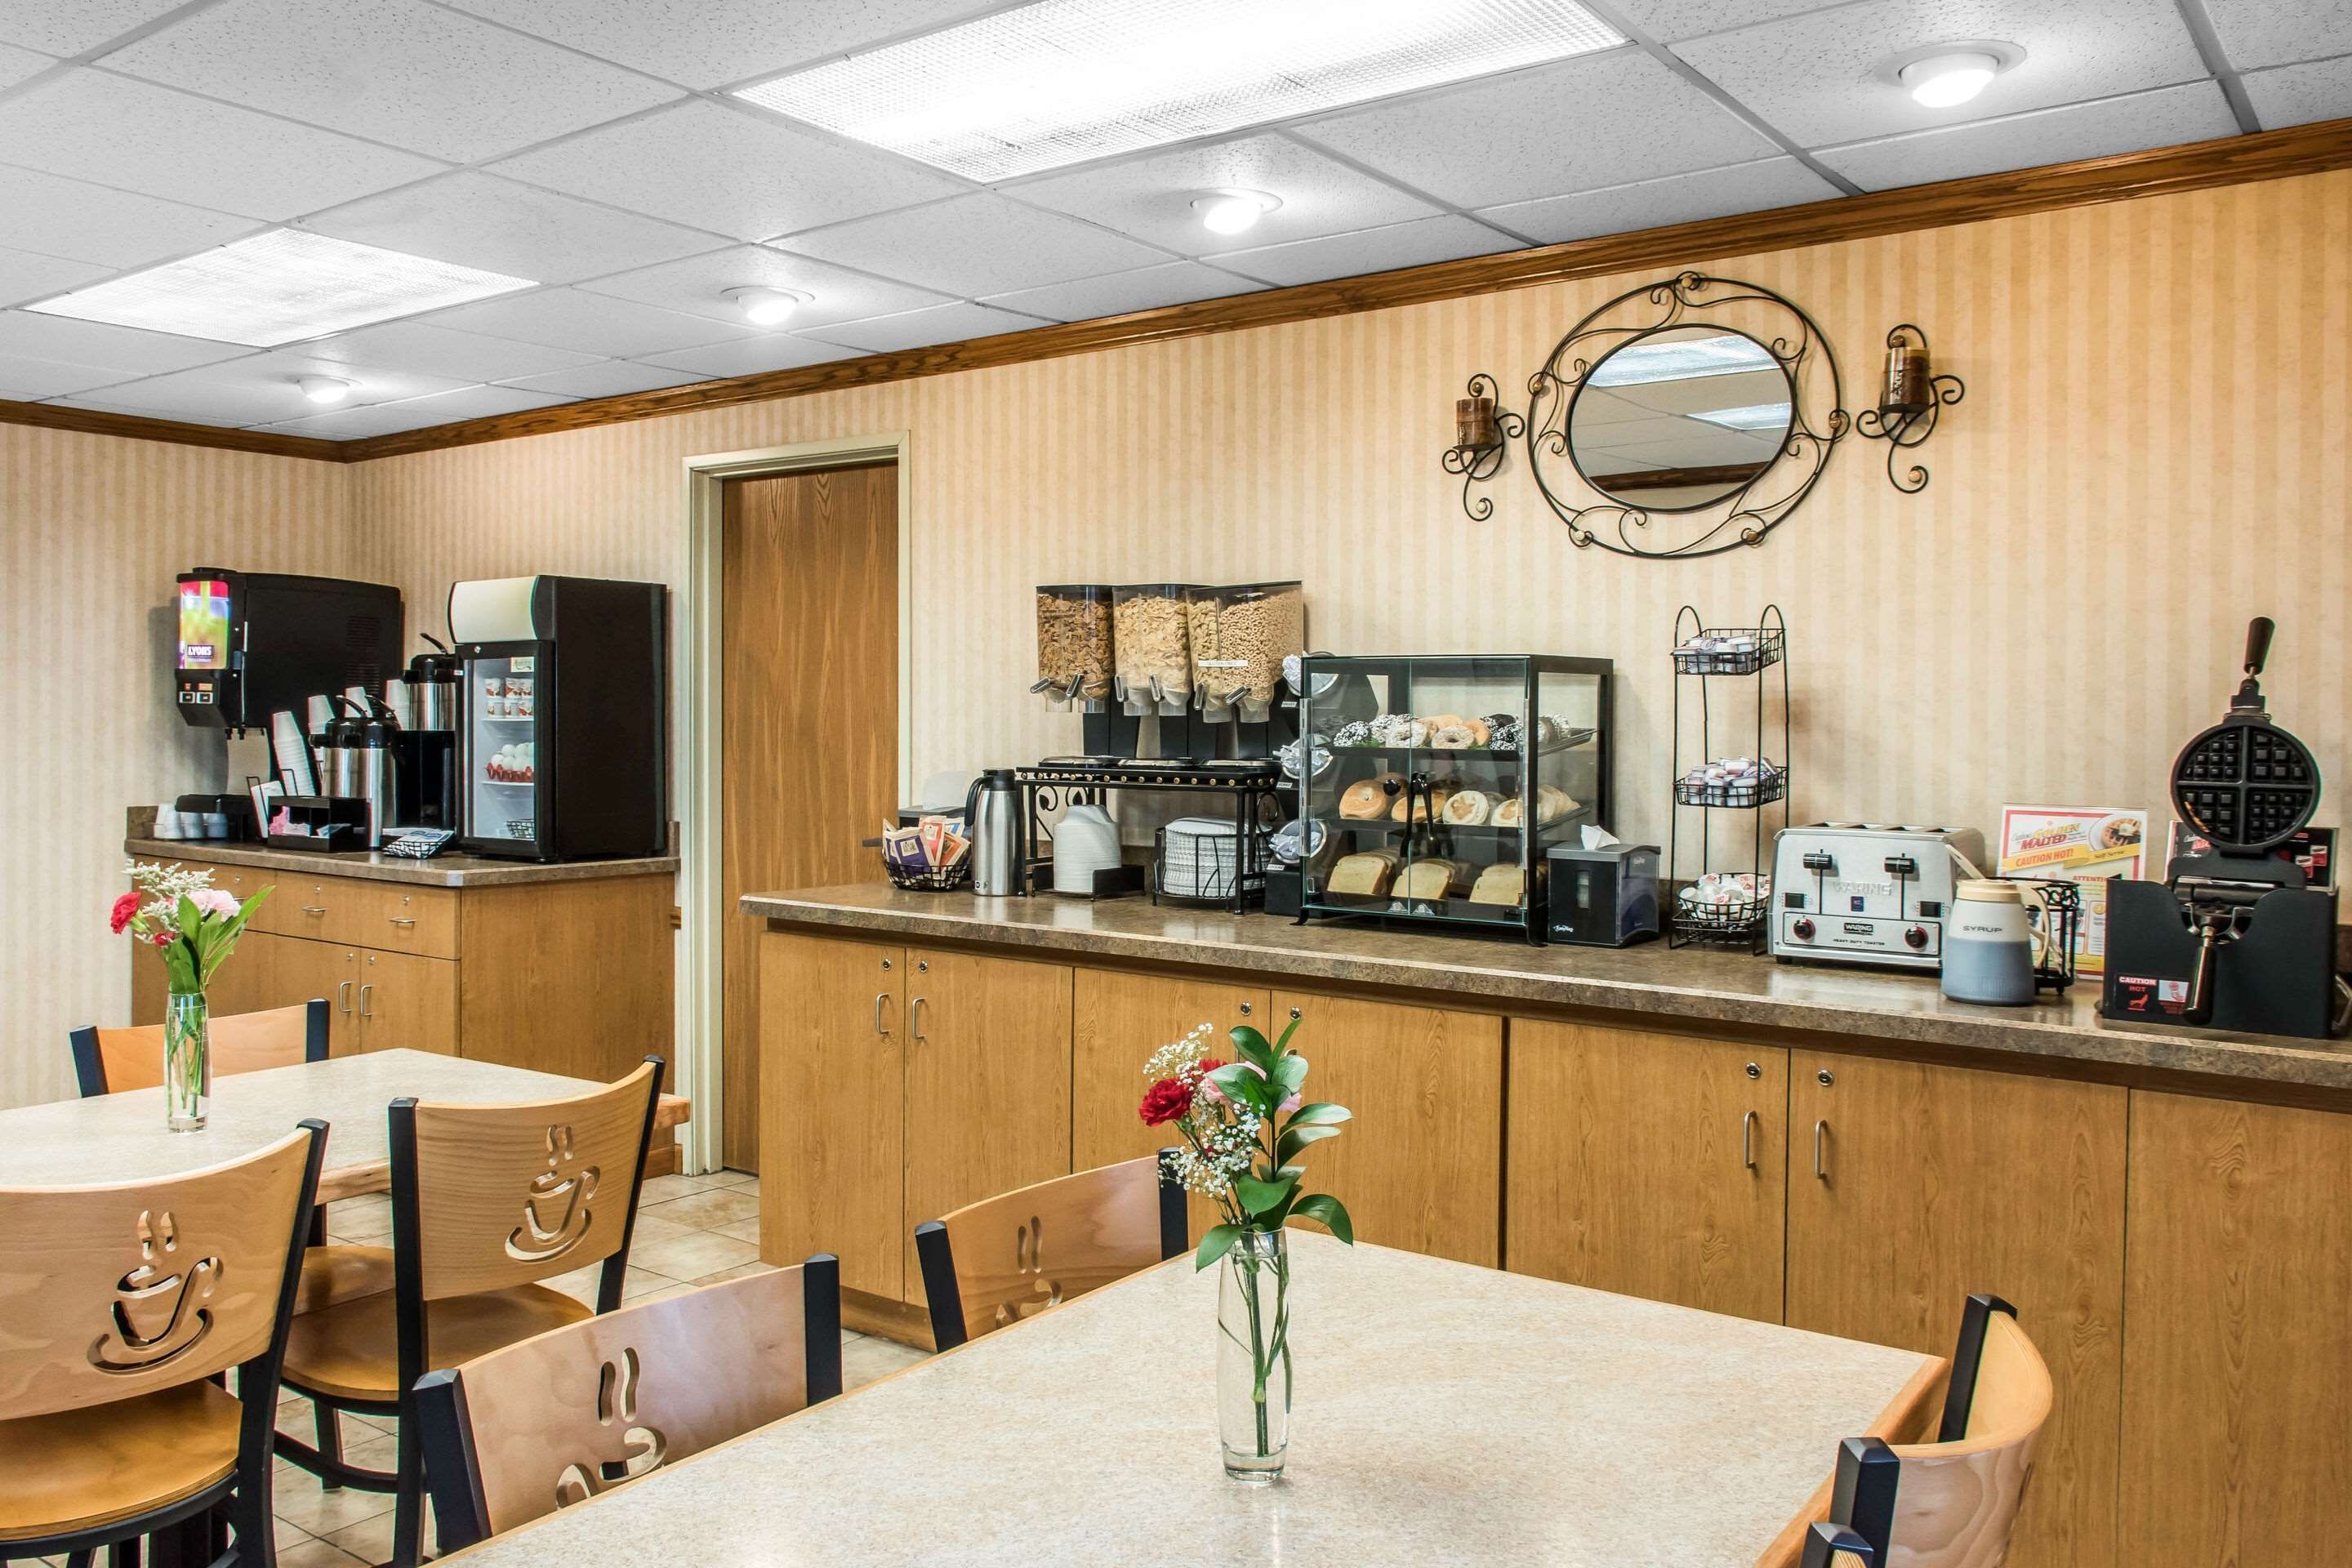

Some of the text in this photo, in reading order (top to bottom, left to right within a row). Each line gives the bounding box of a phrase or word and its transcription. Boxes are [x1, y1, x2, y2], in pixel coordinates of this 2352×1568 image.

[2020, 834, 2067, 850] MALTED
[2016, 849, 2074, 866] CAUTION HOT!
[1833, 882, 1892, 896] WARING
[1845, 924, 1873, 932] WARING
[1962, 924, 2003, 933] SYRUP
[2118, 976, 2157, 987] CAUTION
